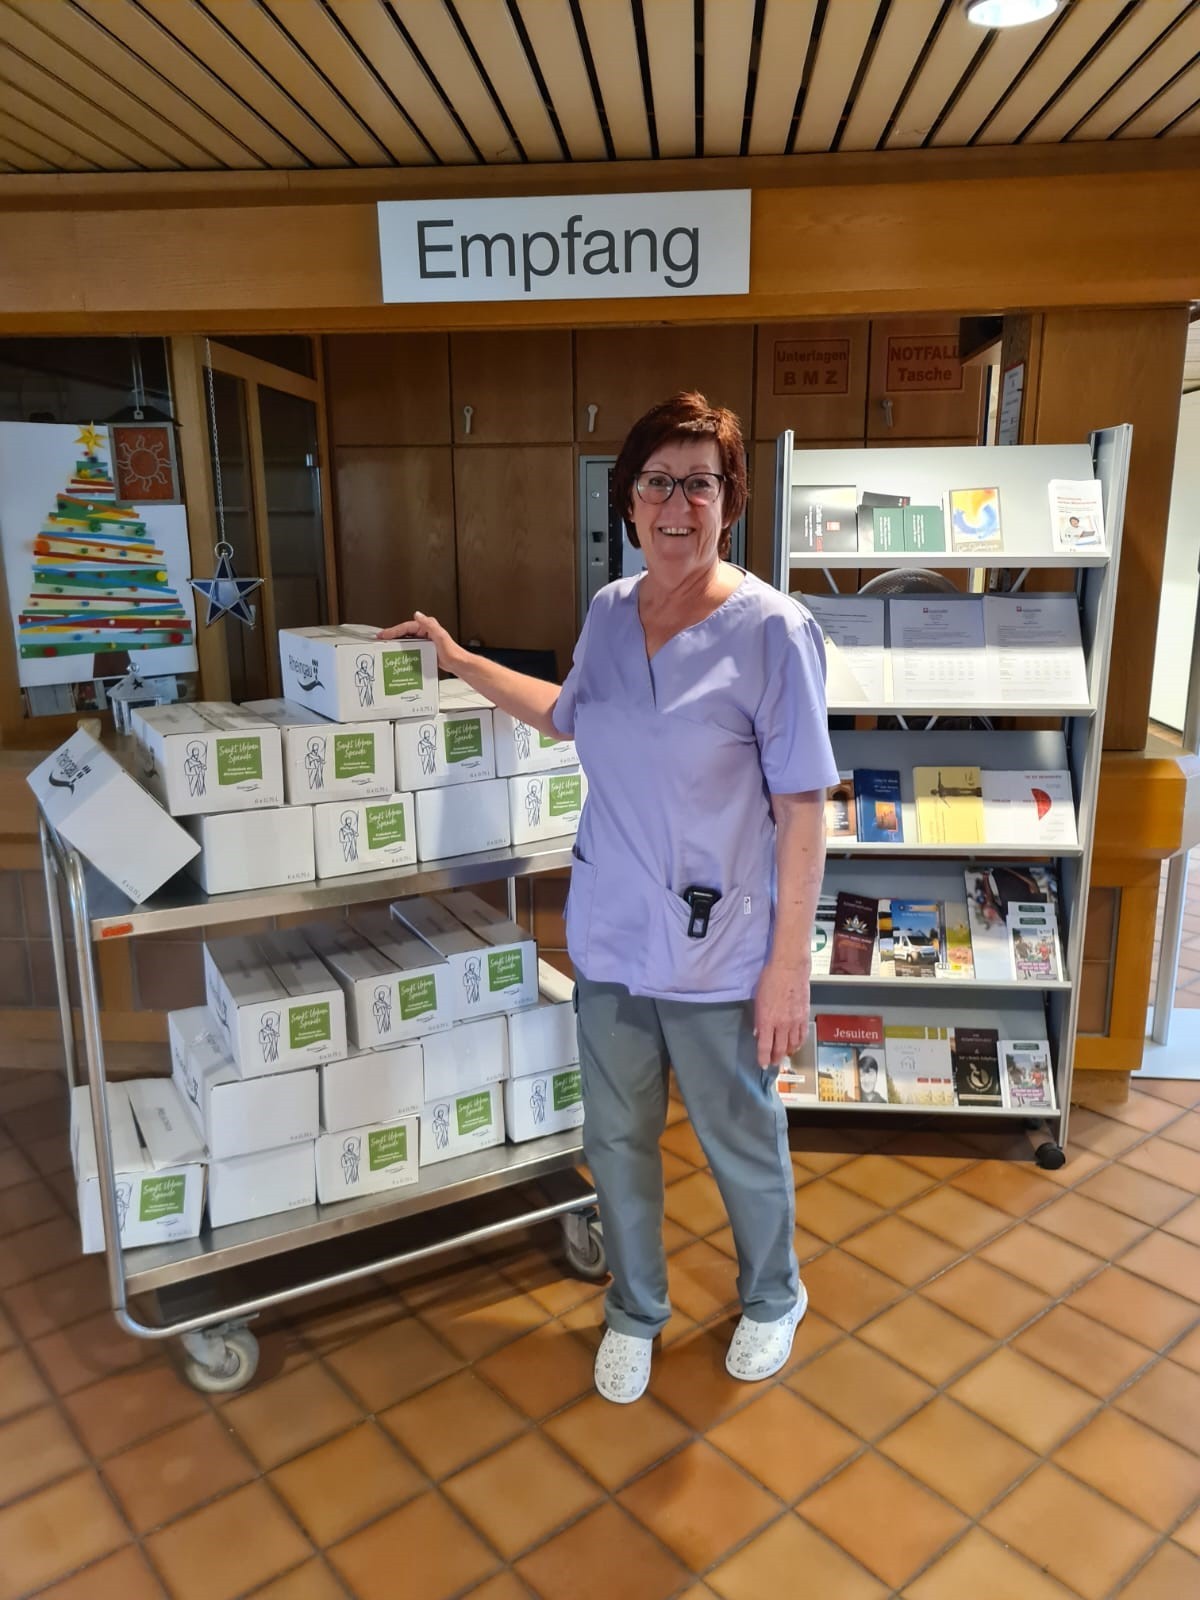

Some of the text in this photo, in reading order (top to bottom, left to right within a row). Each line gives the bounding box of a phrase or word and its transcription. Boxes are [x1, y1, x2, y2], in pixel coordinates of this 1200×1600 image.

[416, 214, 699, 292] Empfang
[776, 350, 847, 364] Unterlagen
[889, 345, 960, 361] NOTFALL
[784, 370, 839, 386] B M Z
[898, 366, 953, 383] Tasche
[833, 1027, 879, 1040] Jesuiten
